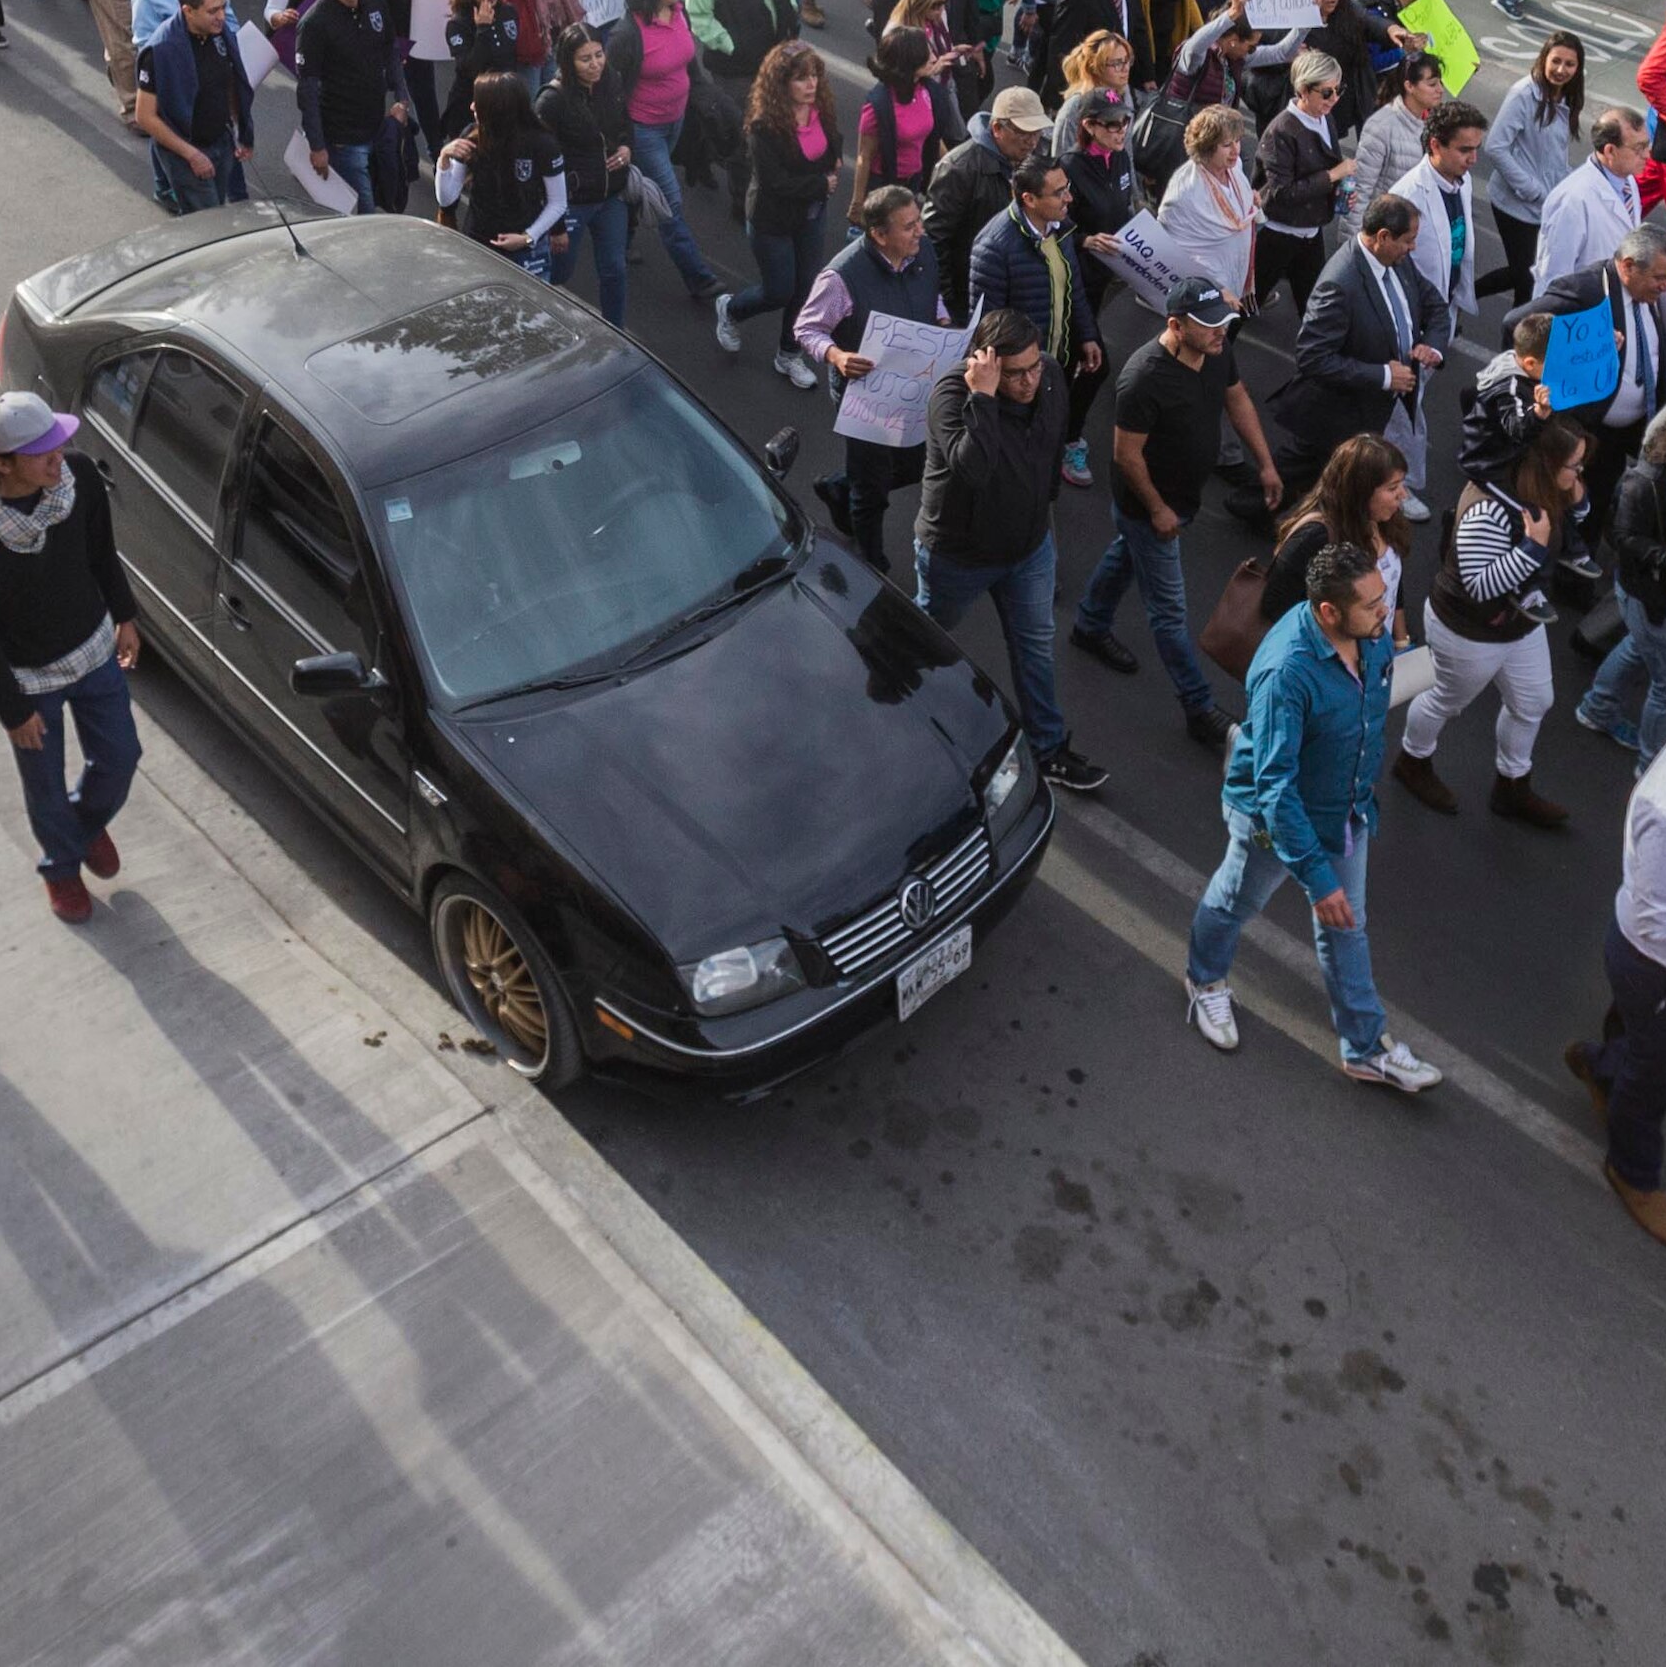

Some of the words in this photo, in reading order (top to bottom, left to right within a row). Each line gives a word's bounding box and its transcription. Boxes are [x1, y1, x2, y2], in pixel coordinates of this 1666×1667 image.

[1124, 229, 1155, 263] UAQ,
[1154, 260, 1174, 278] mi
[1562, 316, 1590, 344] Yo
[1561, 378, 1578, 399] la
